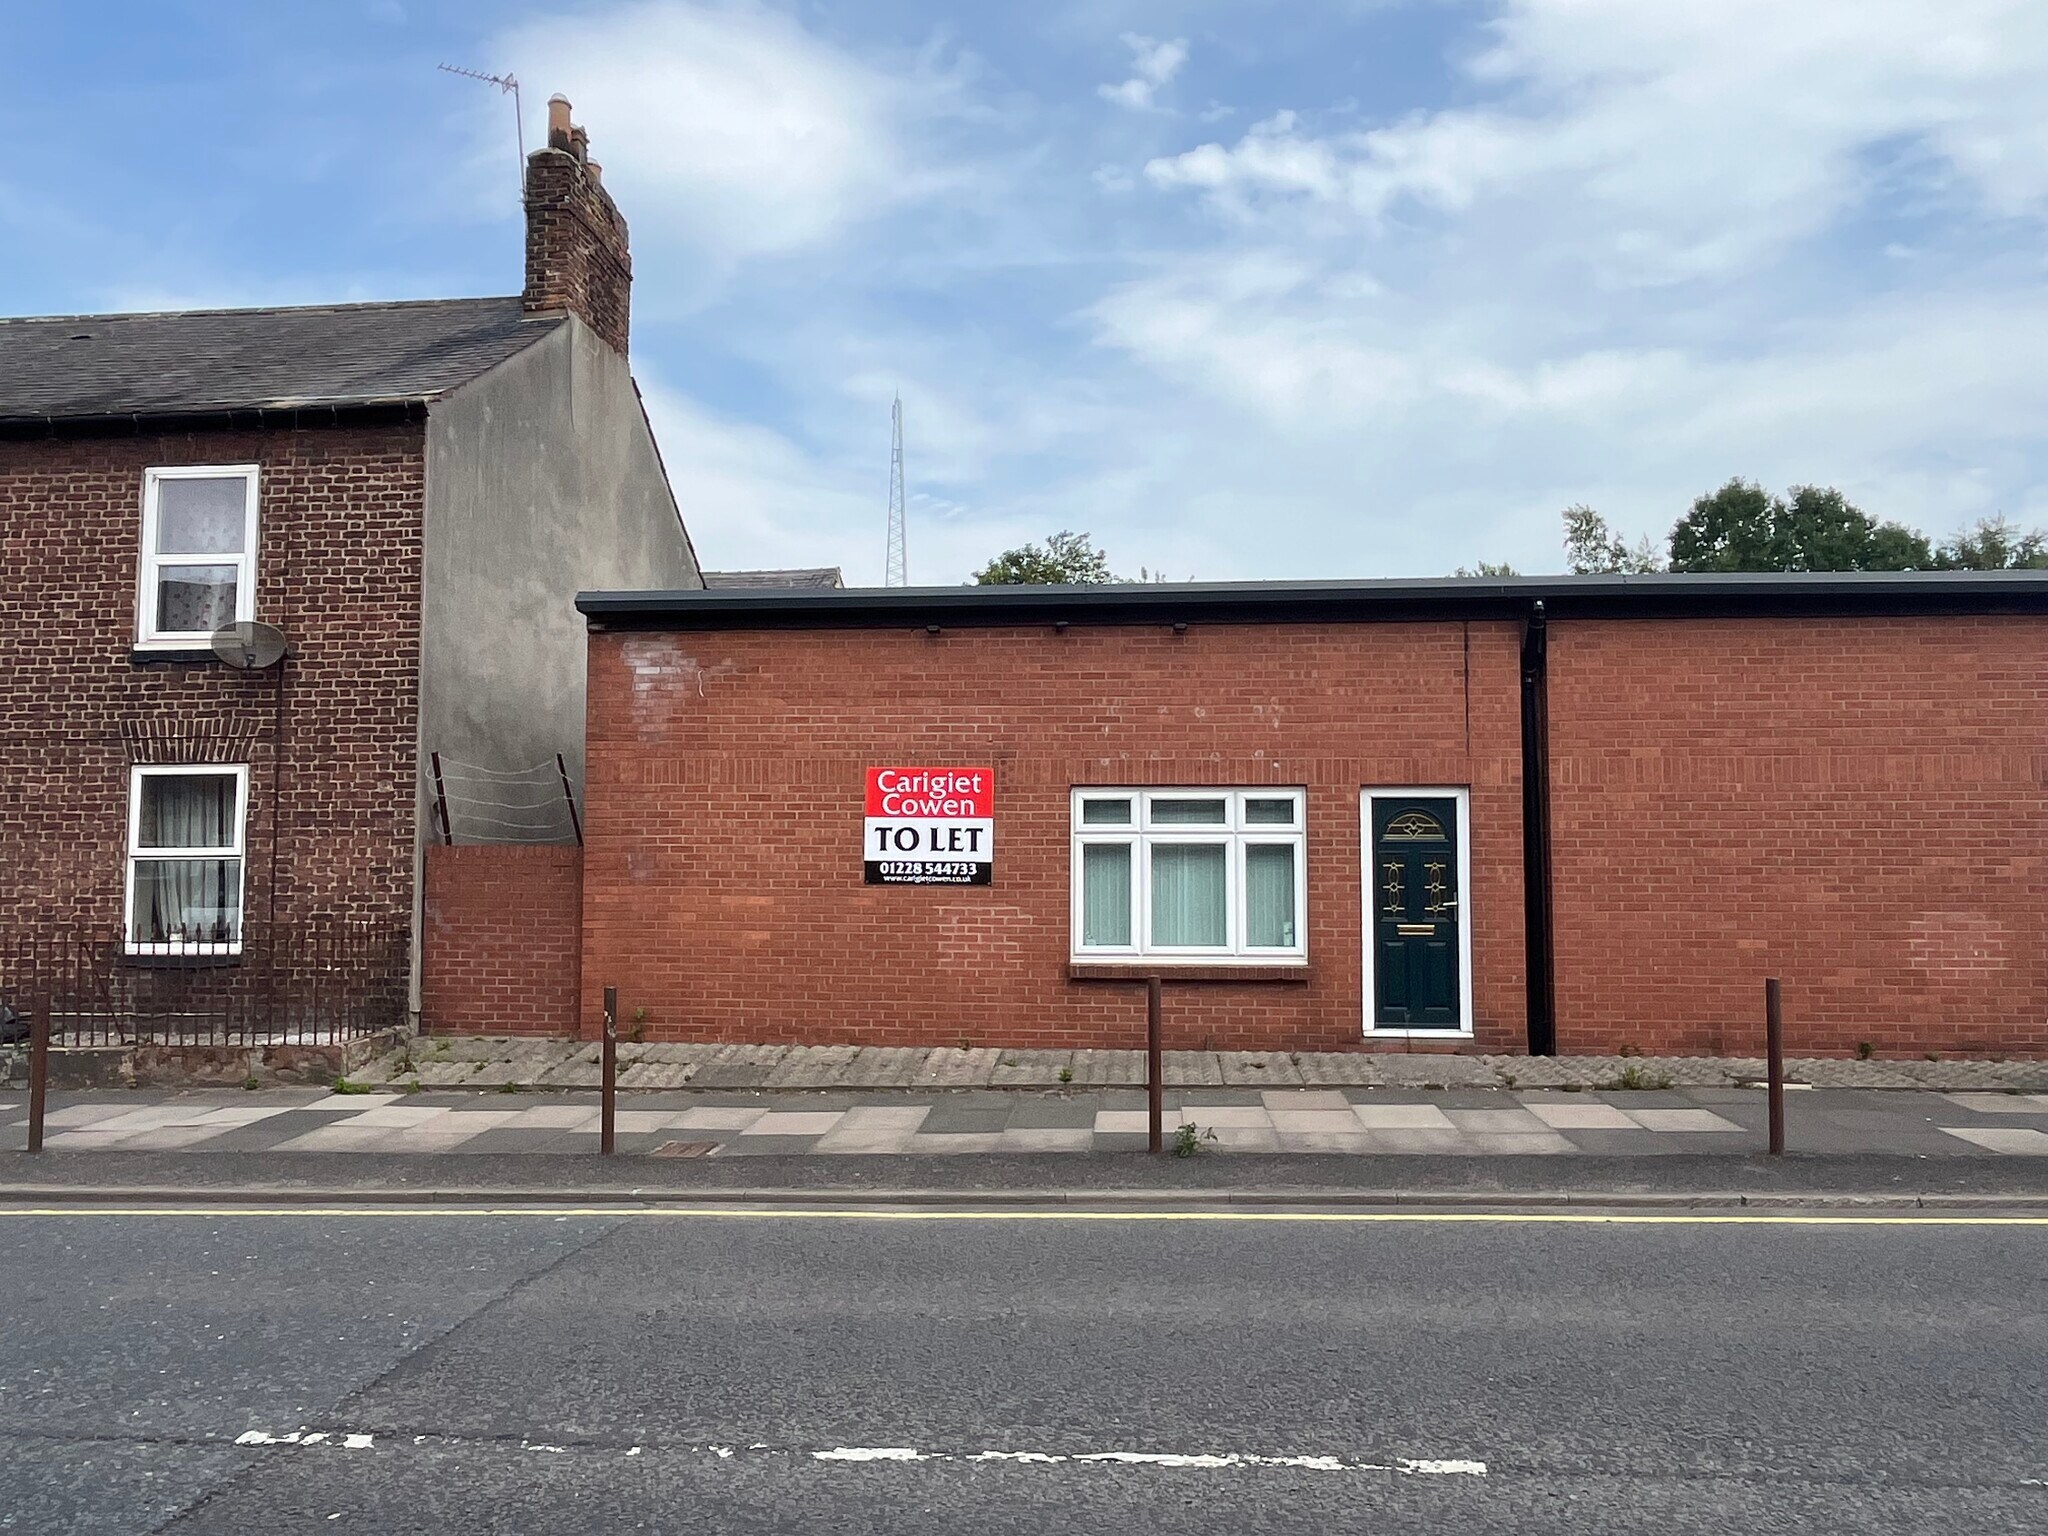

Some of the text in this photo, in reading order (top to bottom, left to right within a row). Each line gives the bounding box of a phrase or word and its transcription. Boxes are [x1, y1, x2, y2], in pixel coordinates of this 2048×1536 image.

[877, 770, 982, 799] Carigiet
[882, 793, 975, 815] Cowen
[874, 827, 983, 852] TO LET
[879, 862, 977, 875] 01228 544733
[883, 875, 971, 883] www.carigietcowen.co.uk
